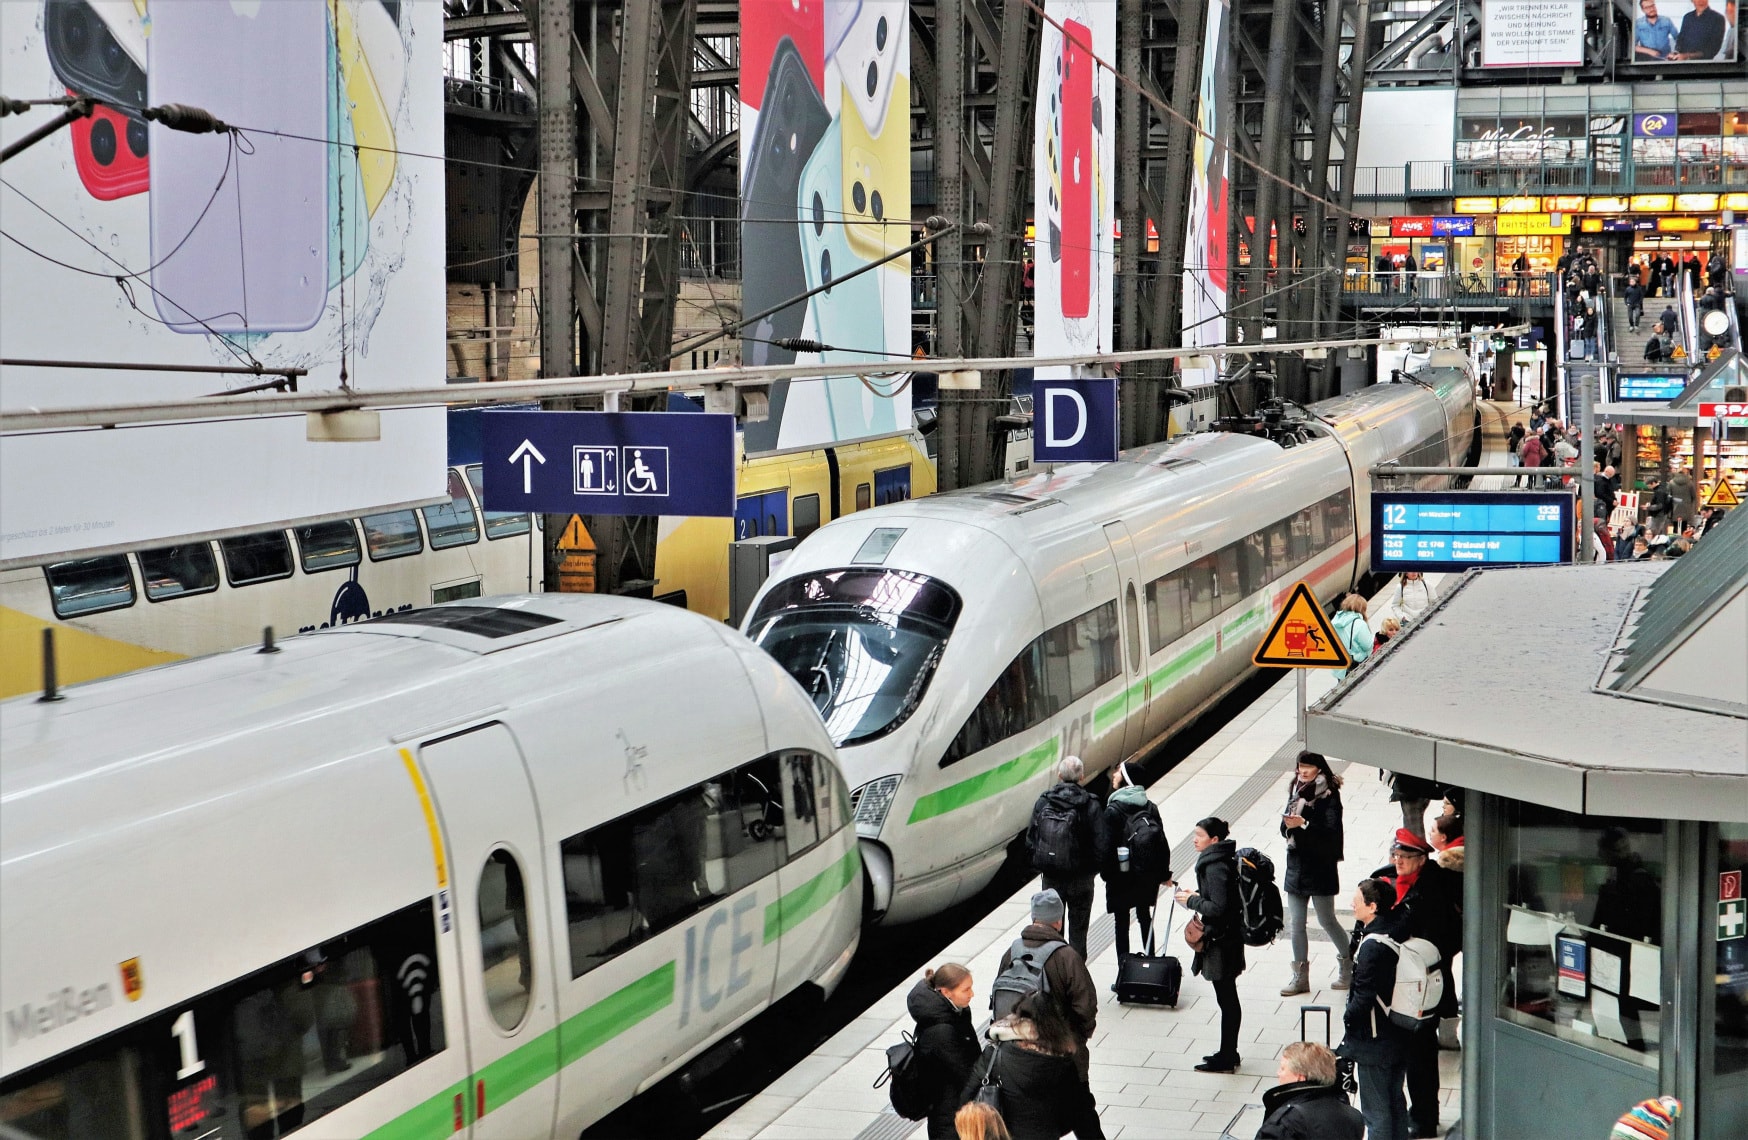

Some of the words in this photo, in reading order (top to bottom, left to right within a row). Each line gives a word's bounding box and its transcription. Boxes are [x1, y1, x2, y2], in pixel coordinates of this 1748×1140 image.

[1648, 120, 1663, 130] 24
[1401, 222, 1424, 232] AVIS
[1518, 336, 1529, 349] E
[1044, 387, 1088, 448] D
[1384, 504, 1406, 524] 12
[740, 519, 746, 540] 2
[678, 890, 758, 1030] ICE
[3, 981, 113, 1049] Meißen
[171, 1009, 206, 1081] 1
